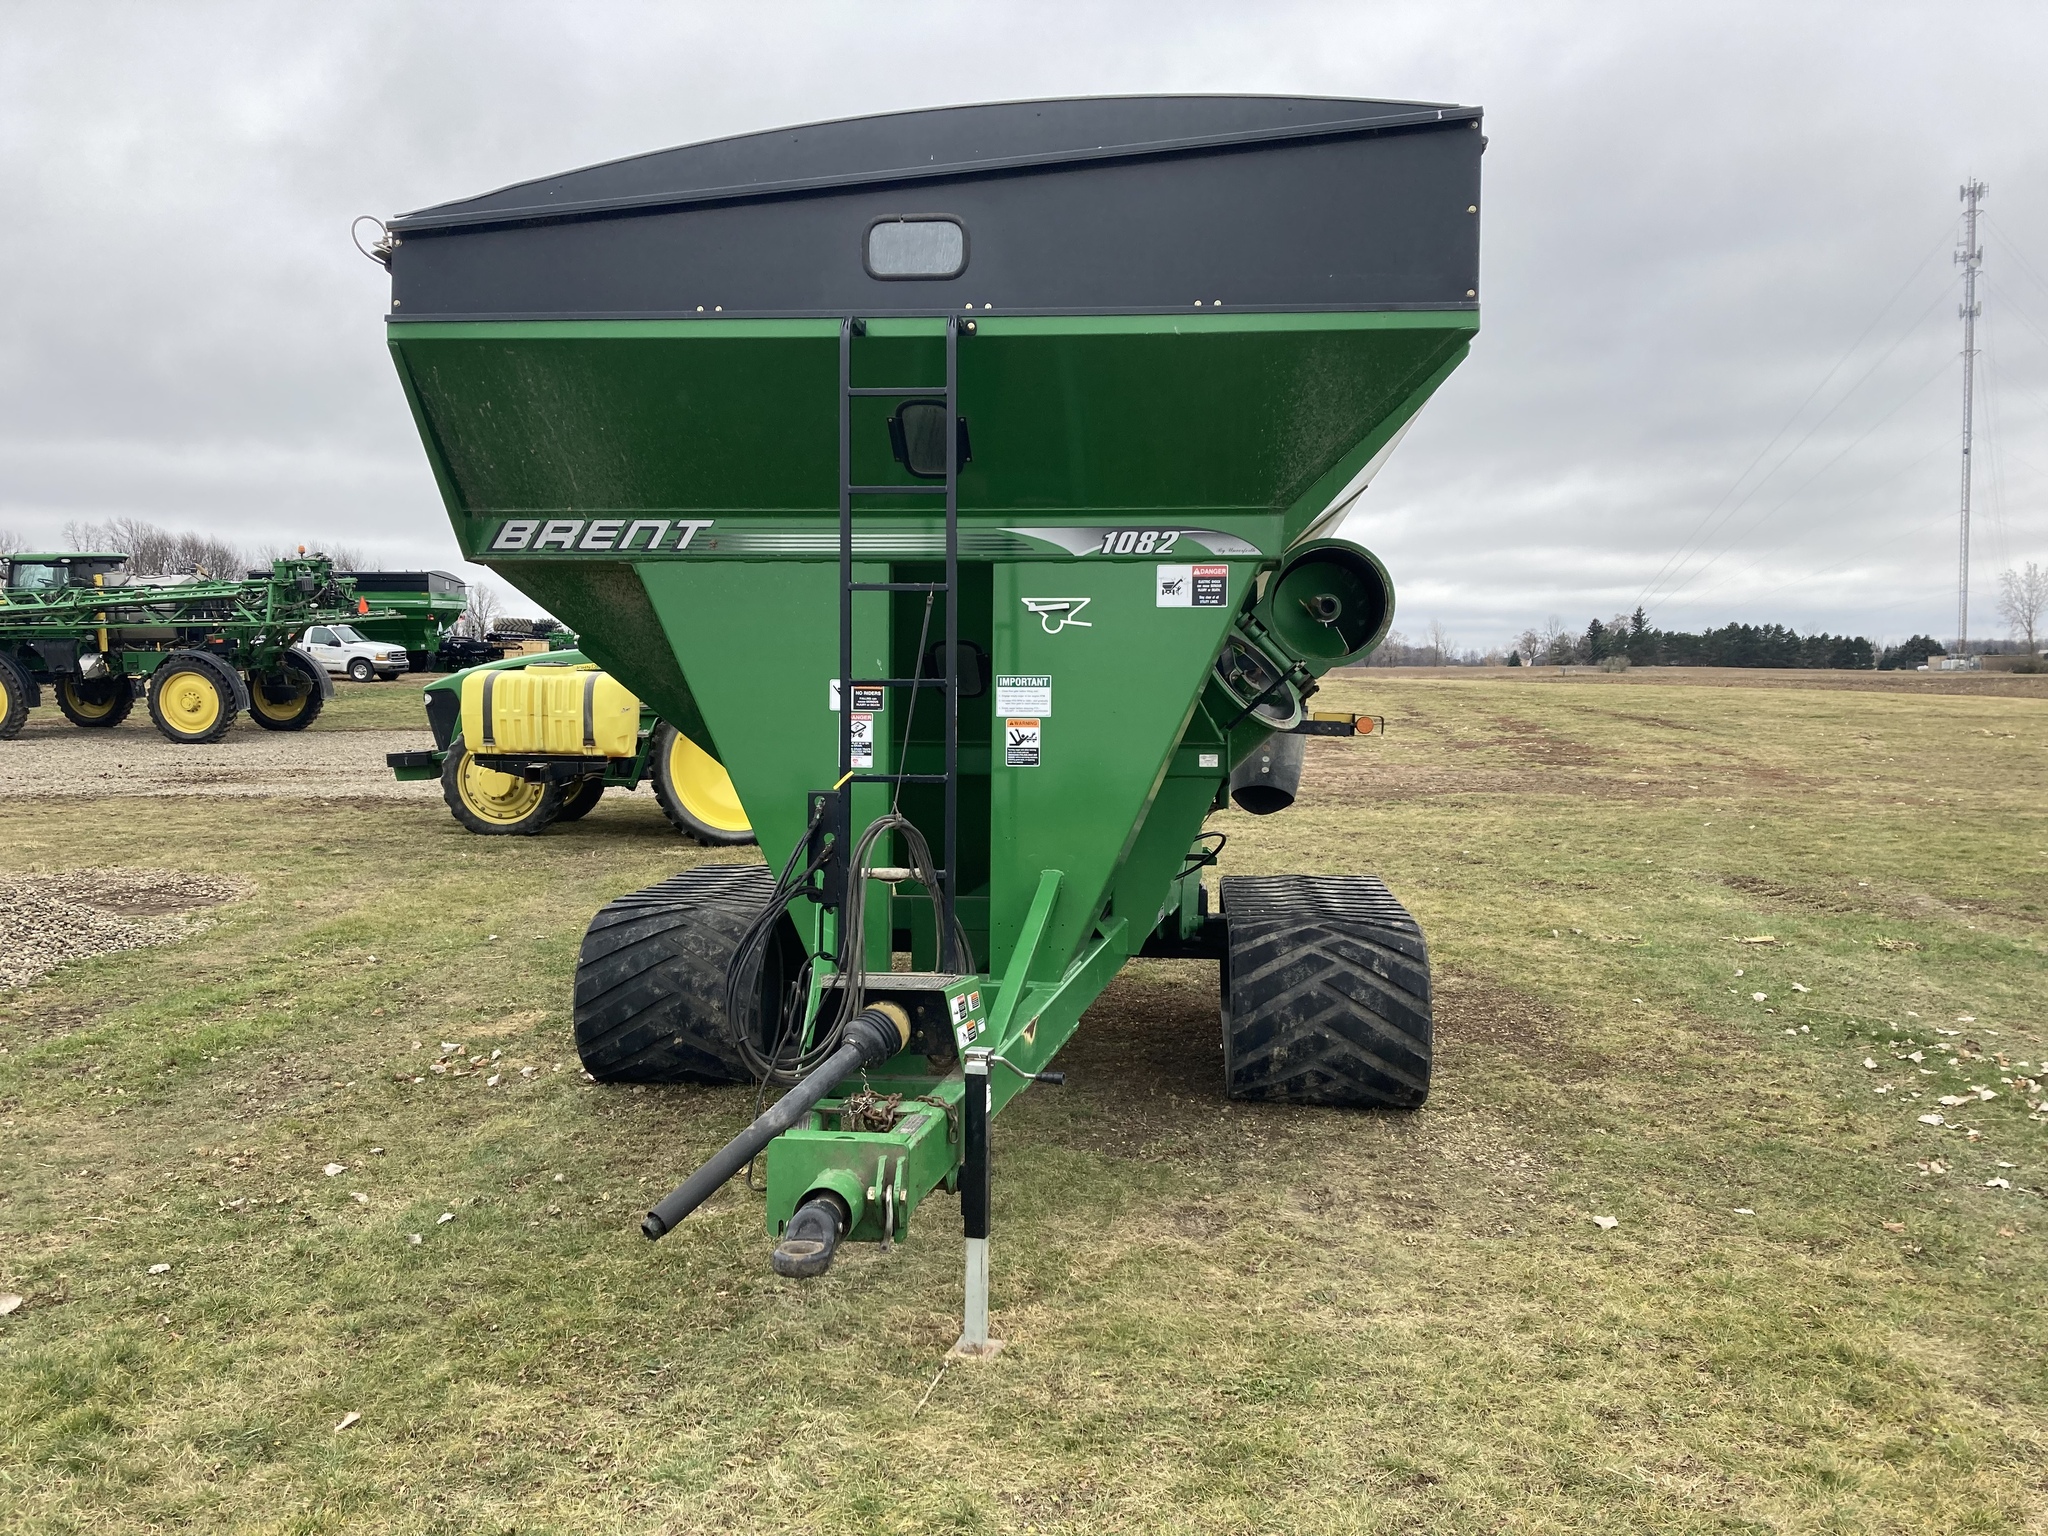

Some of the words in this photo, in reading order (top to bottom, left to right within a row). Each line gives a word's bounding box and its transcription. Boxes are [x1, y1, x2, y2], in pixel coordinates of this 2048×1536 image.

[488, 519, 715, 551] BRENT
[1101, 530, 1181, 554] 1082
[999, 677, 1048, 687] IMPORTANT
